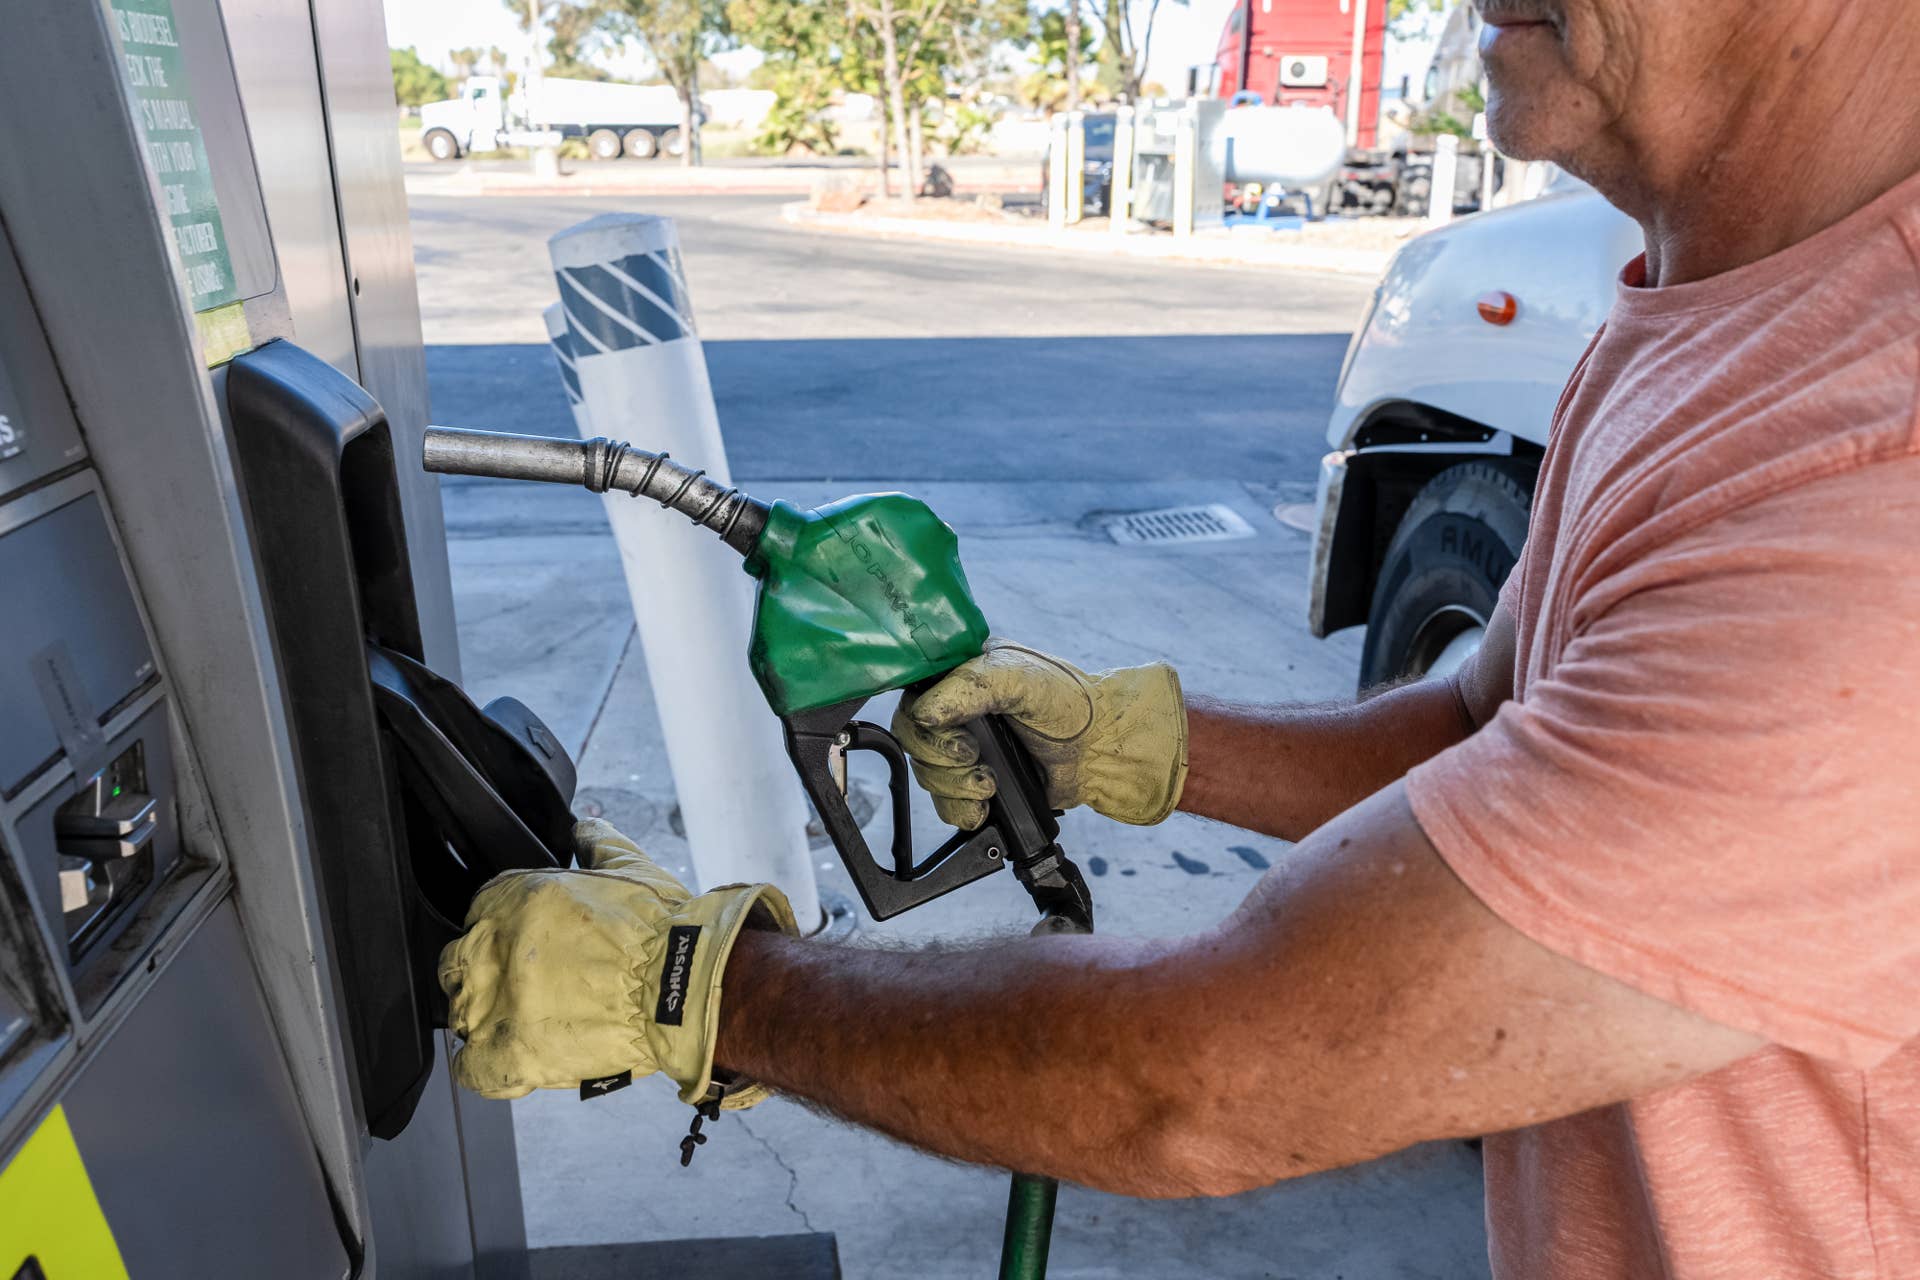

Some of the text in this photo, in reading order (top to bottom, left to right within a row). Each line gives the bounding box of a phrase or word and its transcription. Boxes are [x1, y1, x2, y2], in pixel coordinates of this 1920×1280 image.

[150, 99, 195, 131] MANUAL
[165, 141, 197, 173] YOUR
[669, 935, 690, 990] HUSKY
